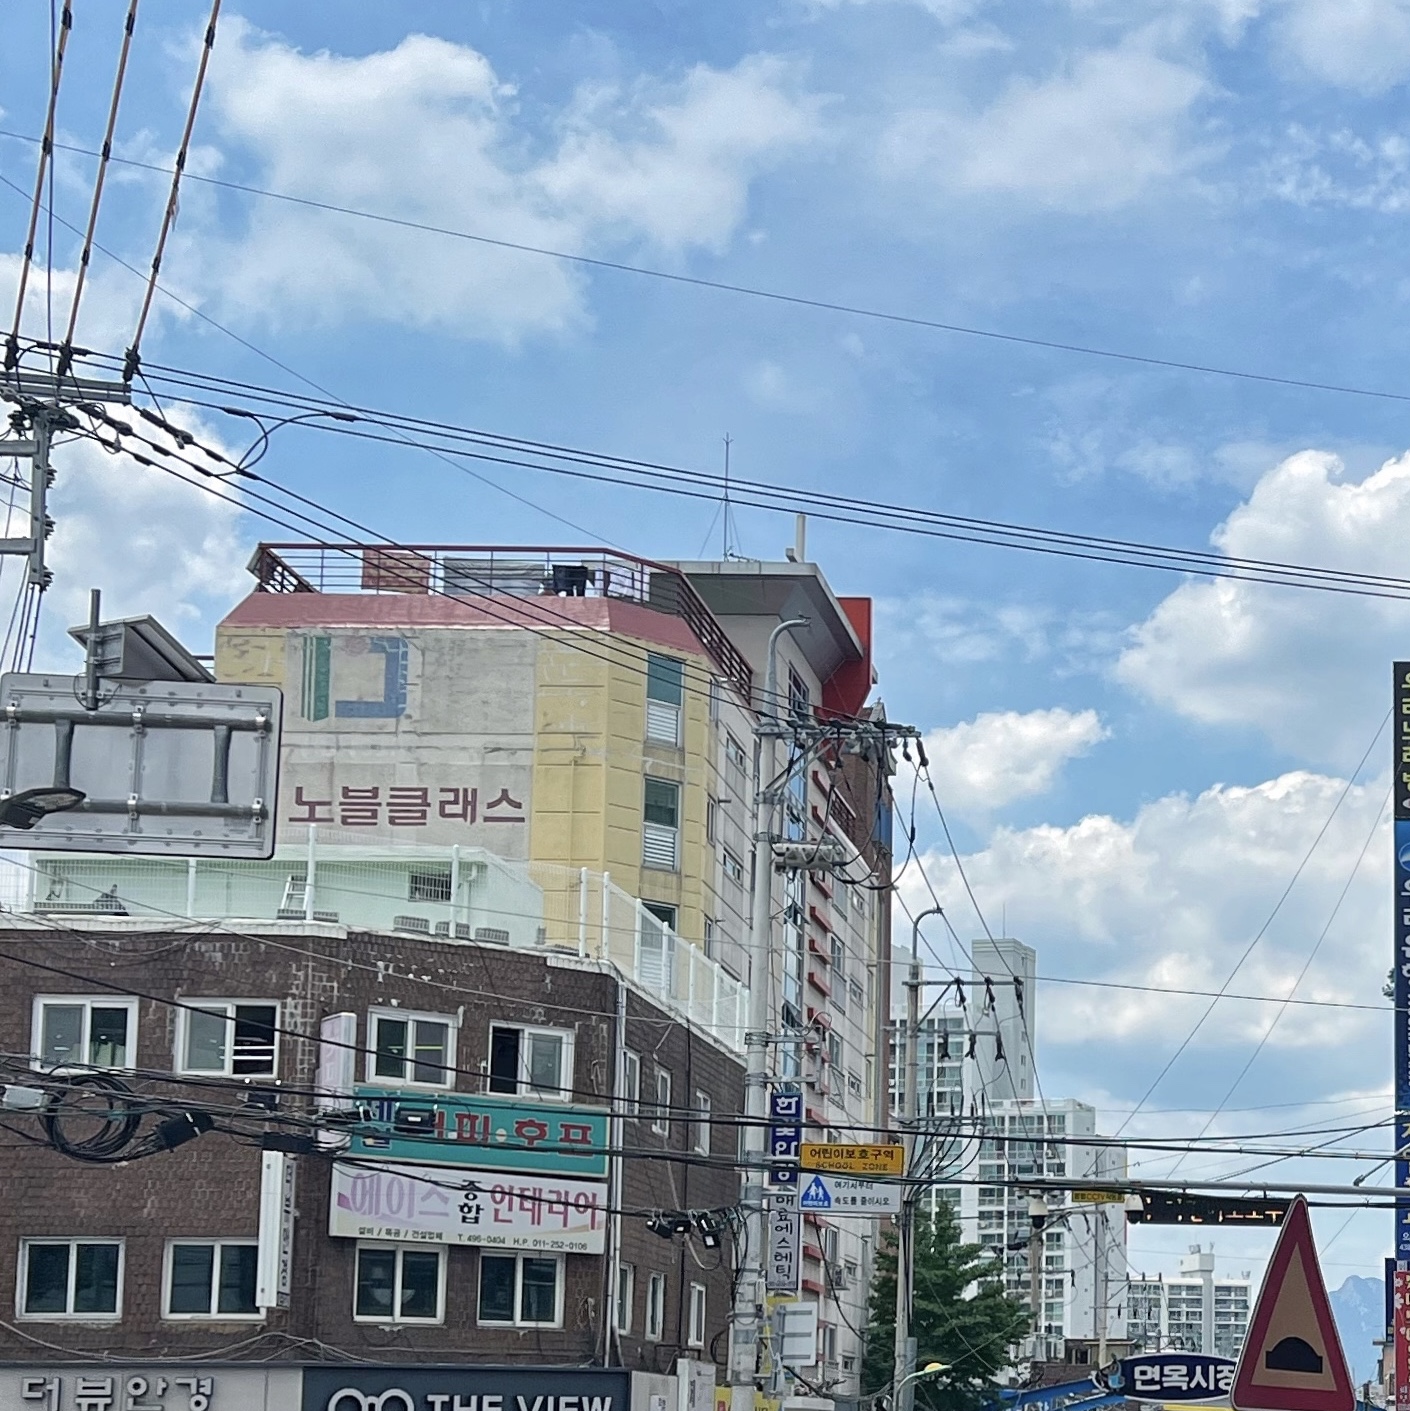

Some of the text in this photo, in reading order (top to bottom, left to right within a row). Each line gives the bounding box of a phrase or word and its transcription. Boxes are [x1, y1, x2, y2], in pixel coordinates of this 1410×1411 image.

[288, 785, 527, 827] 노블클래스
[809, 1148, 895, 1162] 어린이보호구역
[815, 1162, 889, 1171] SCHOOL ZONE
[350, 1173, 599, 1231] 에이스 종합 인테리어
